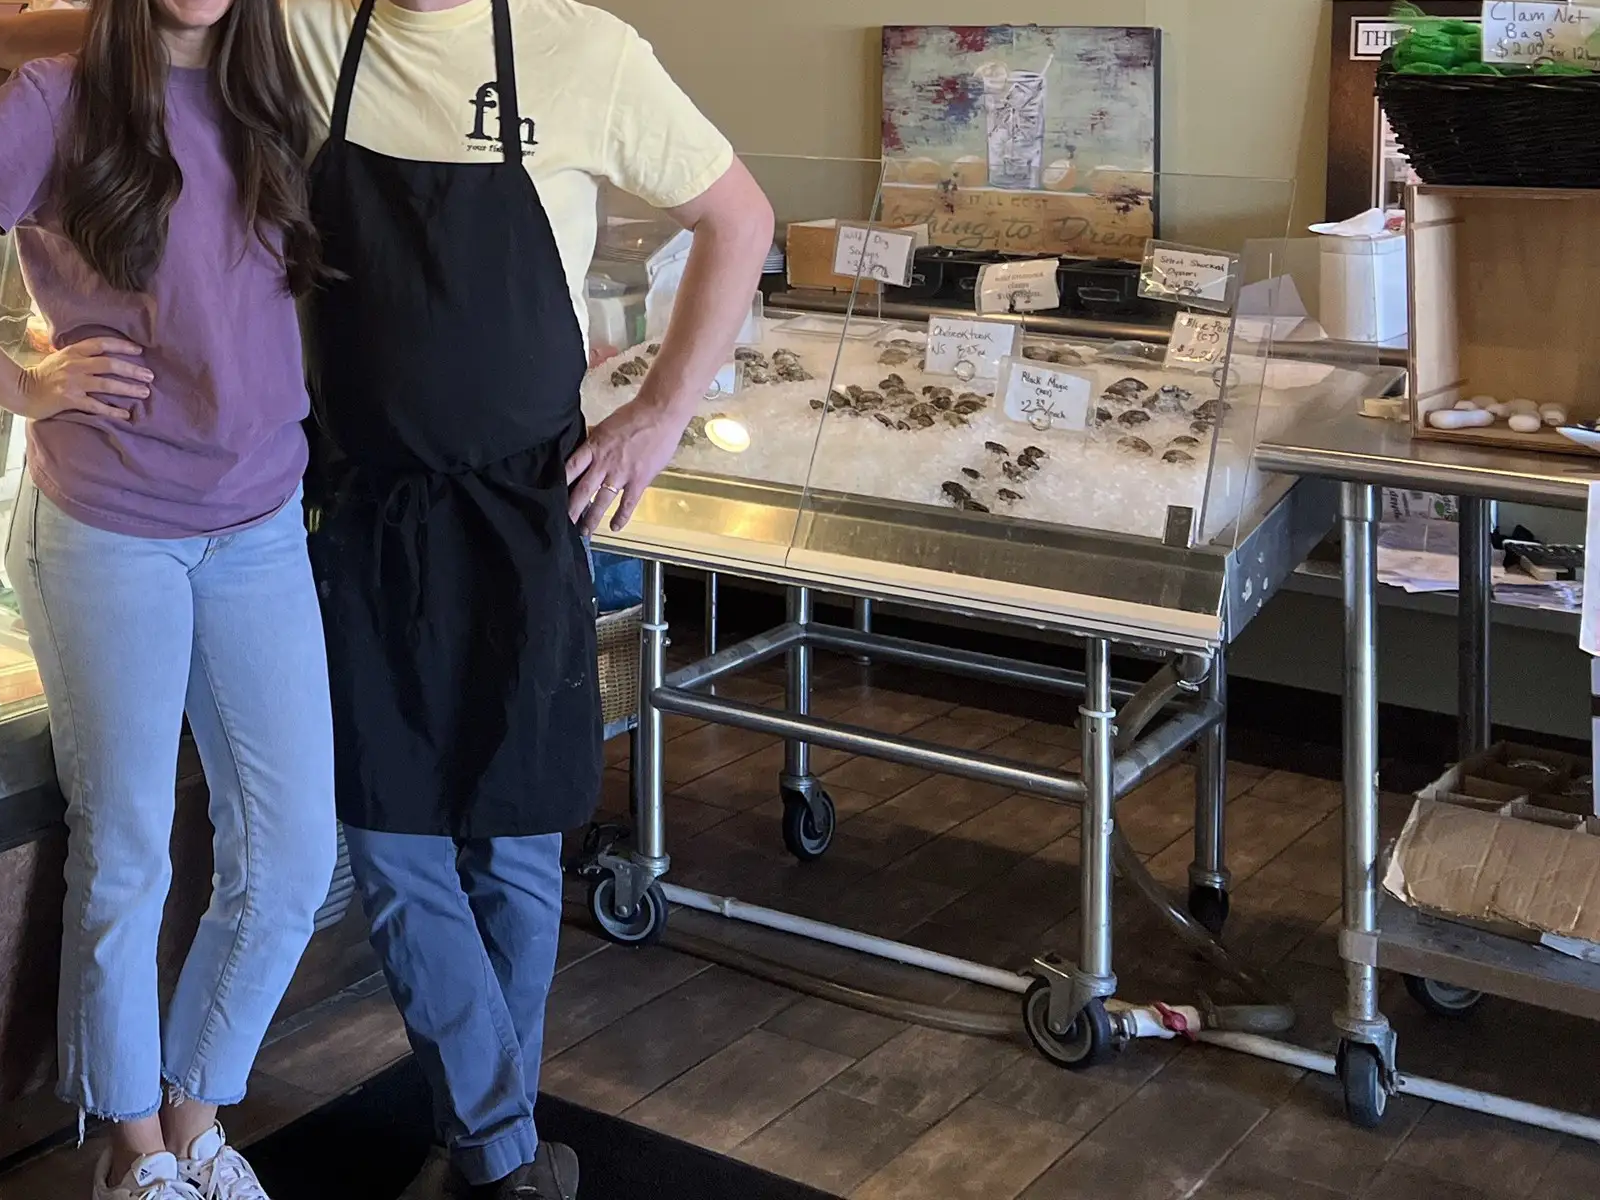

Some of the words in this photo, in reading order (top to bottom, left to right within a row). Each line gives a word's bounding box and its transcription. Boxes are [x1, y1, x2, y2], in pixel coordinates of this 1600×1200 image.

[1491, 0, 1544, 22] Clam
[1554, 7, 1590, 24] Net
[1505, 22, 1555, 46] Bags
[465, 81, 538, 146] fn
[1022, 370, 1041, 385] Black
